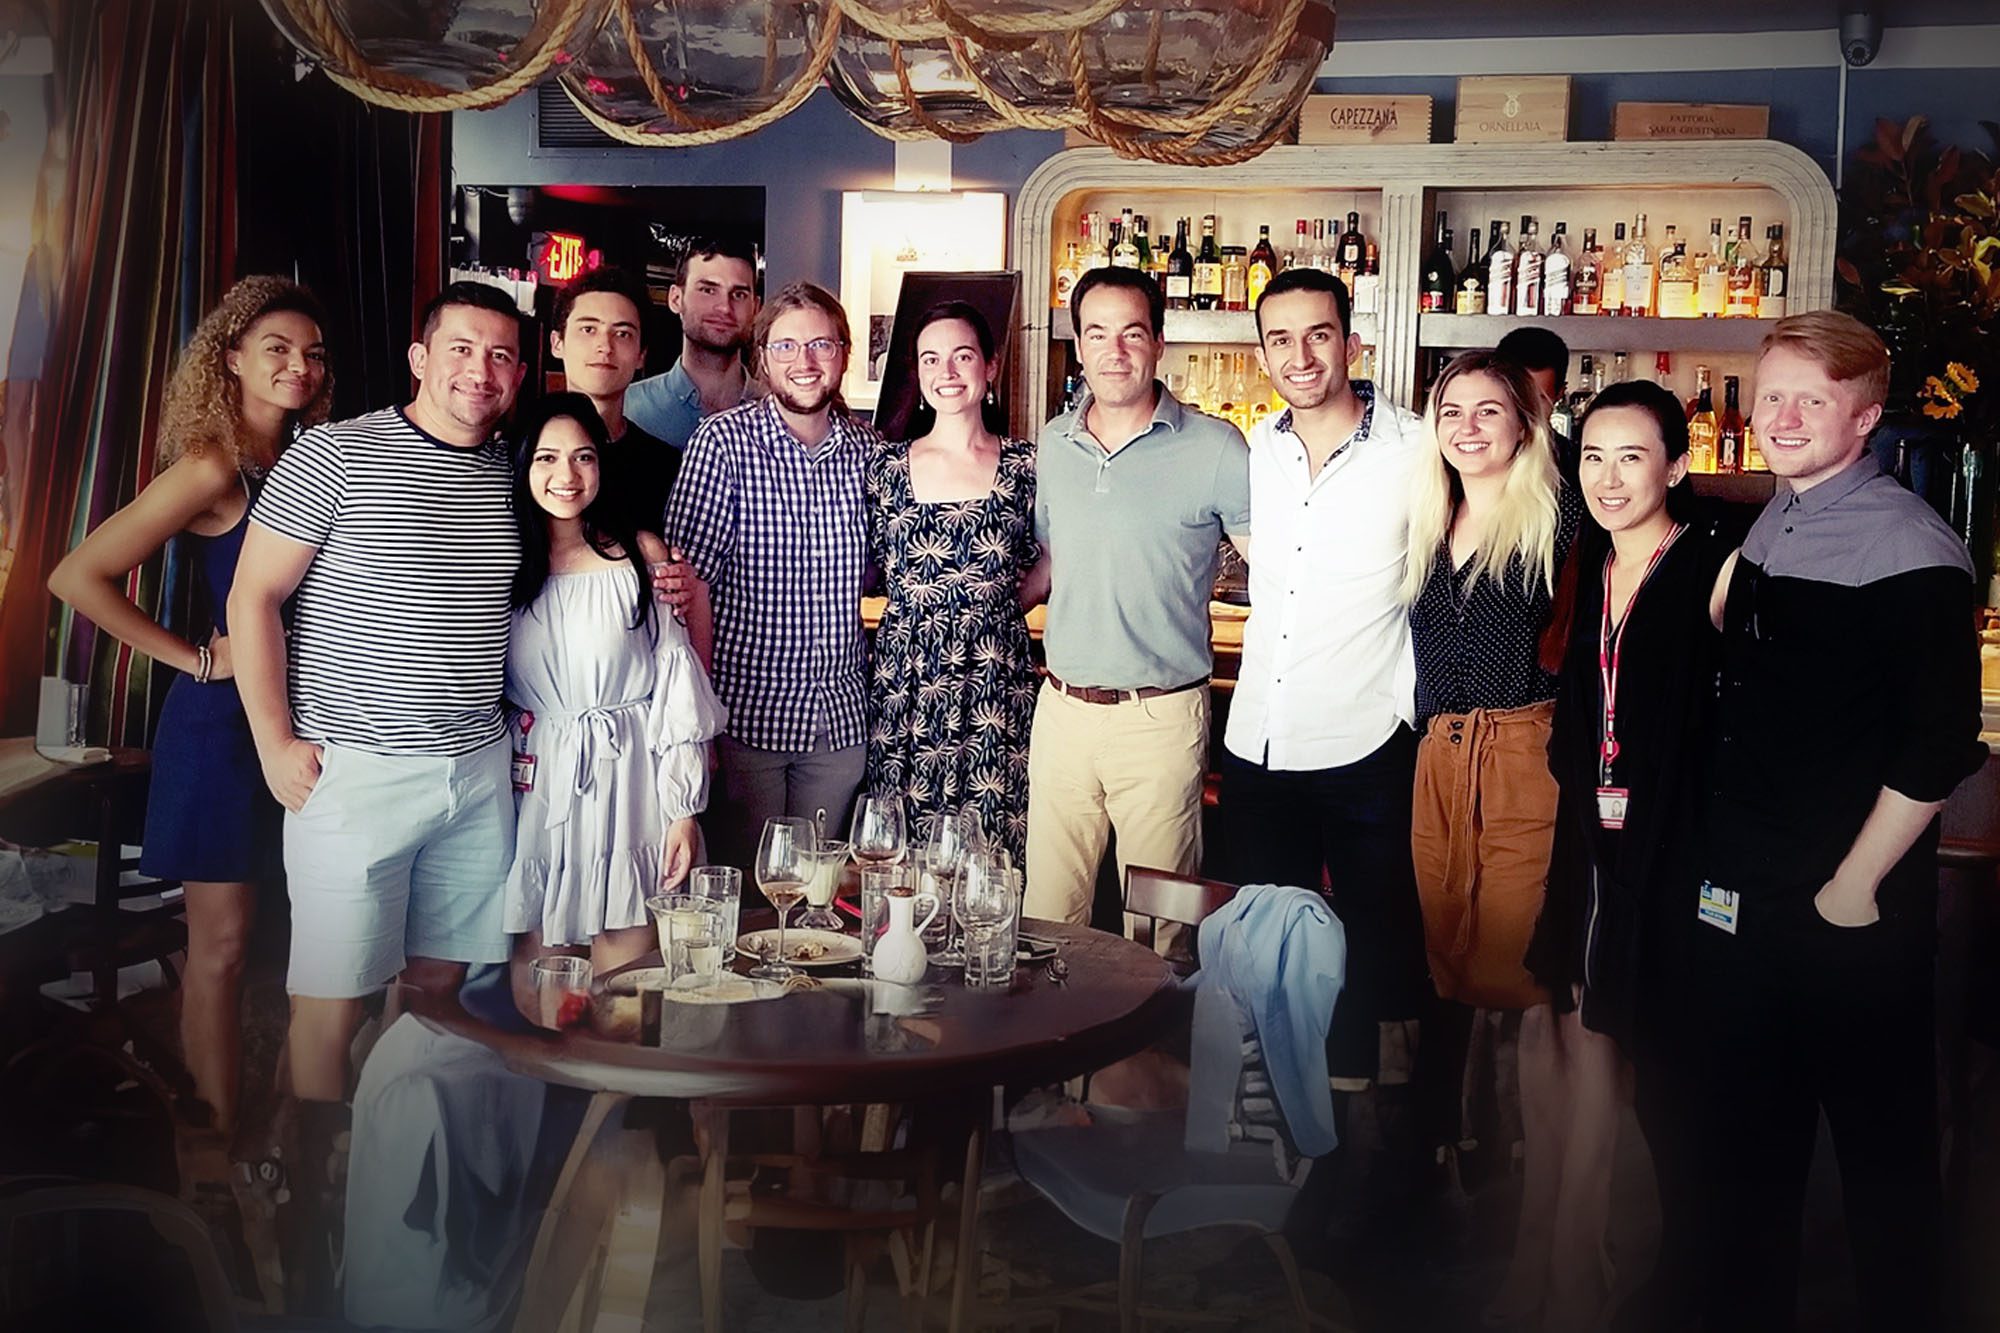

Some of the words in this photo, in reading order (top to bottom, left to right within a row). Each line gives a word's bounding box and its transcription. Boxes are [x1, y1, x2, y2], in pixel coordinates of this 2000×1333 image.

[1330, 107, 1398, 125] CAPEZZANA
[1479, 121, 1542, 132] ORNELLAIA
[549, 235, 581, 280] EXIT
